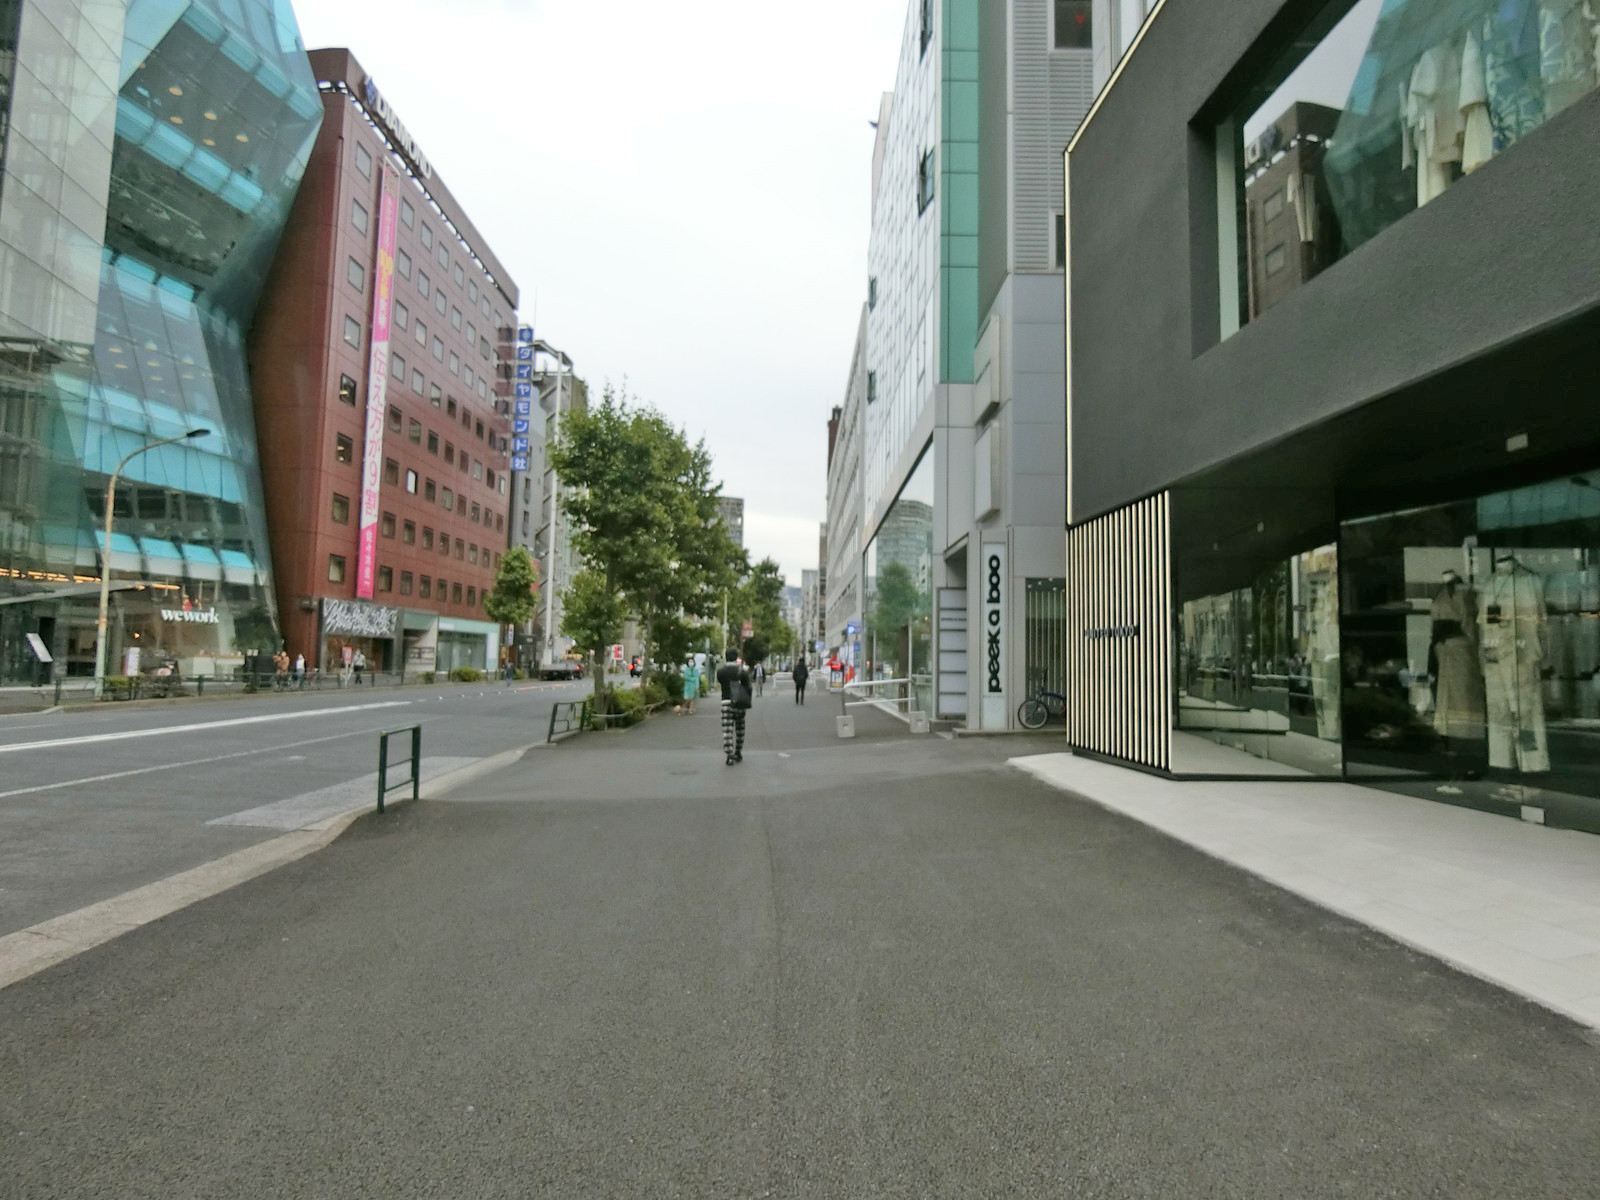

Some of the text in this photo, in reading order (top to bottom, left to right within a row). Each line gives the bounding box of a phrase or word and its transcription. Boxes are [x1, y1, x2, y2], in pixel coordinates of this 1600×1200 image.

[375, 95, 432, 179] DIAMOND
[514, 347, 531, 470] ダイヤモンド社
[986, 554, 1001, 604] boo
[160, 606, 220, 625] wework
[988, 609, 1001, 626] a
[1110, 624, 1134, 638] TOKYO
[987, 626, 1002, 693] peek
